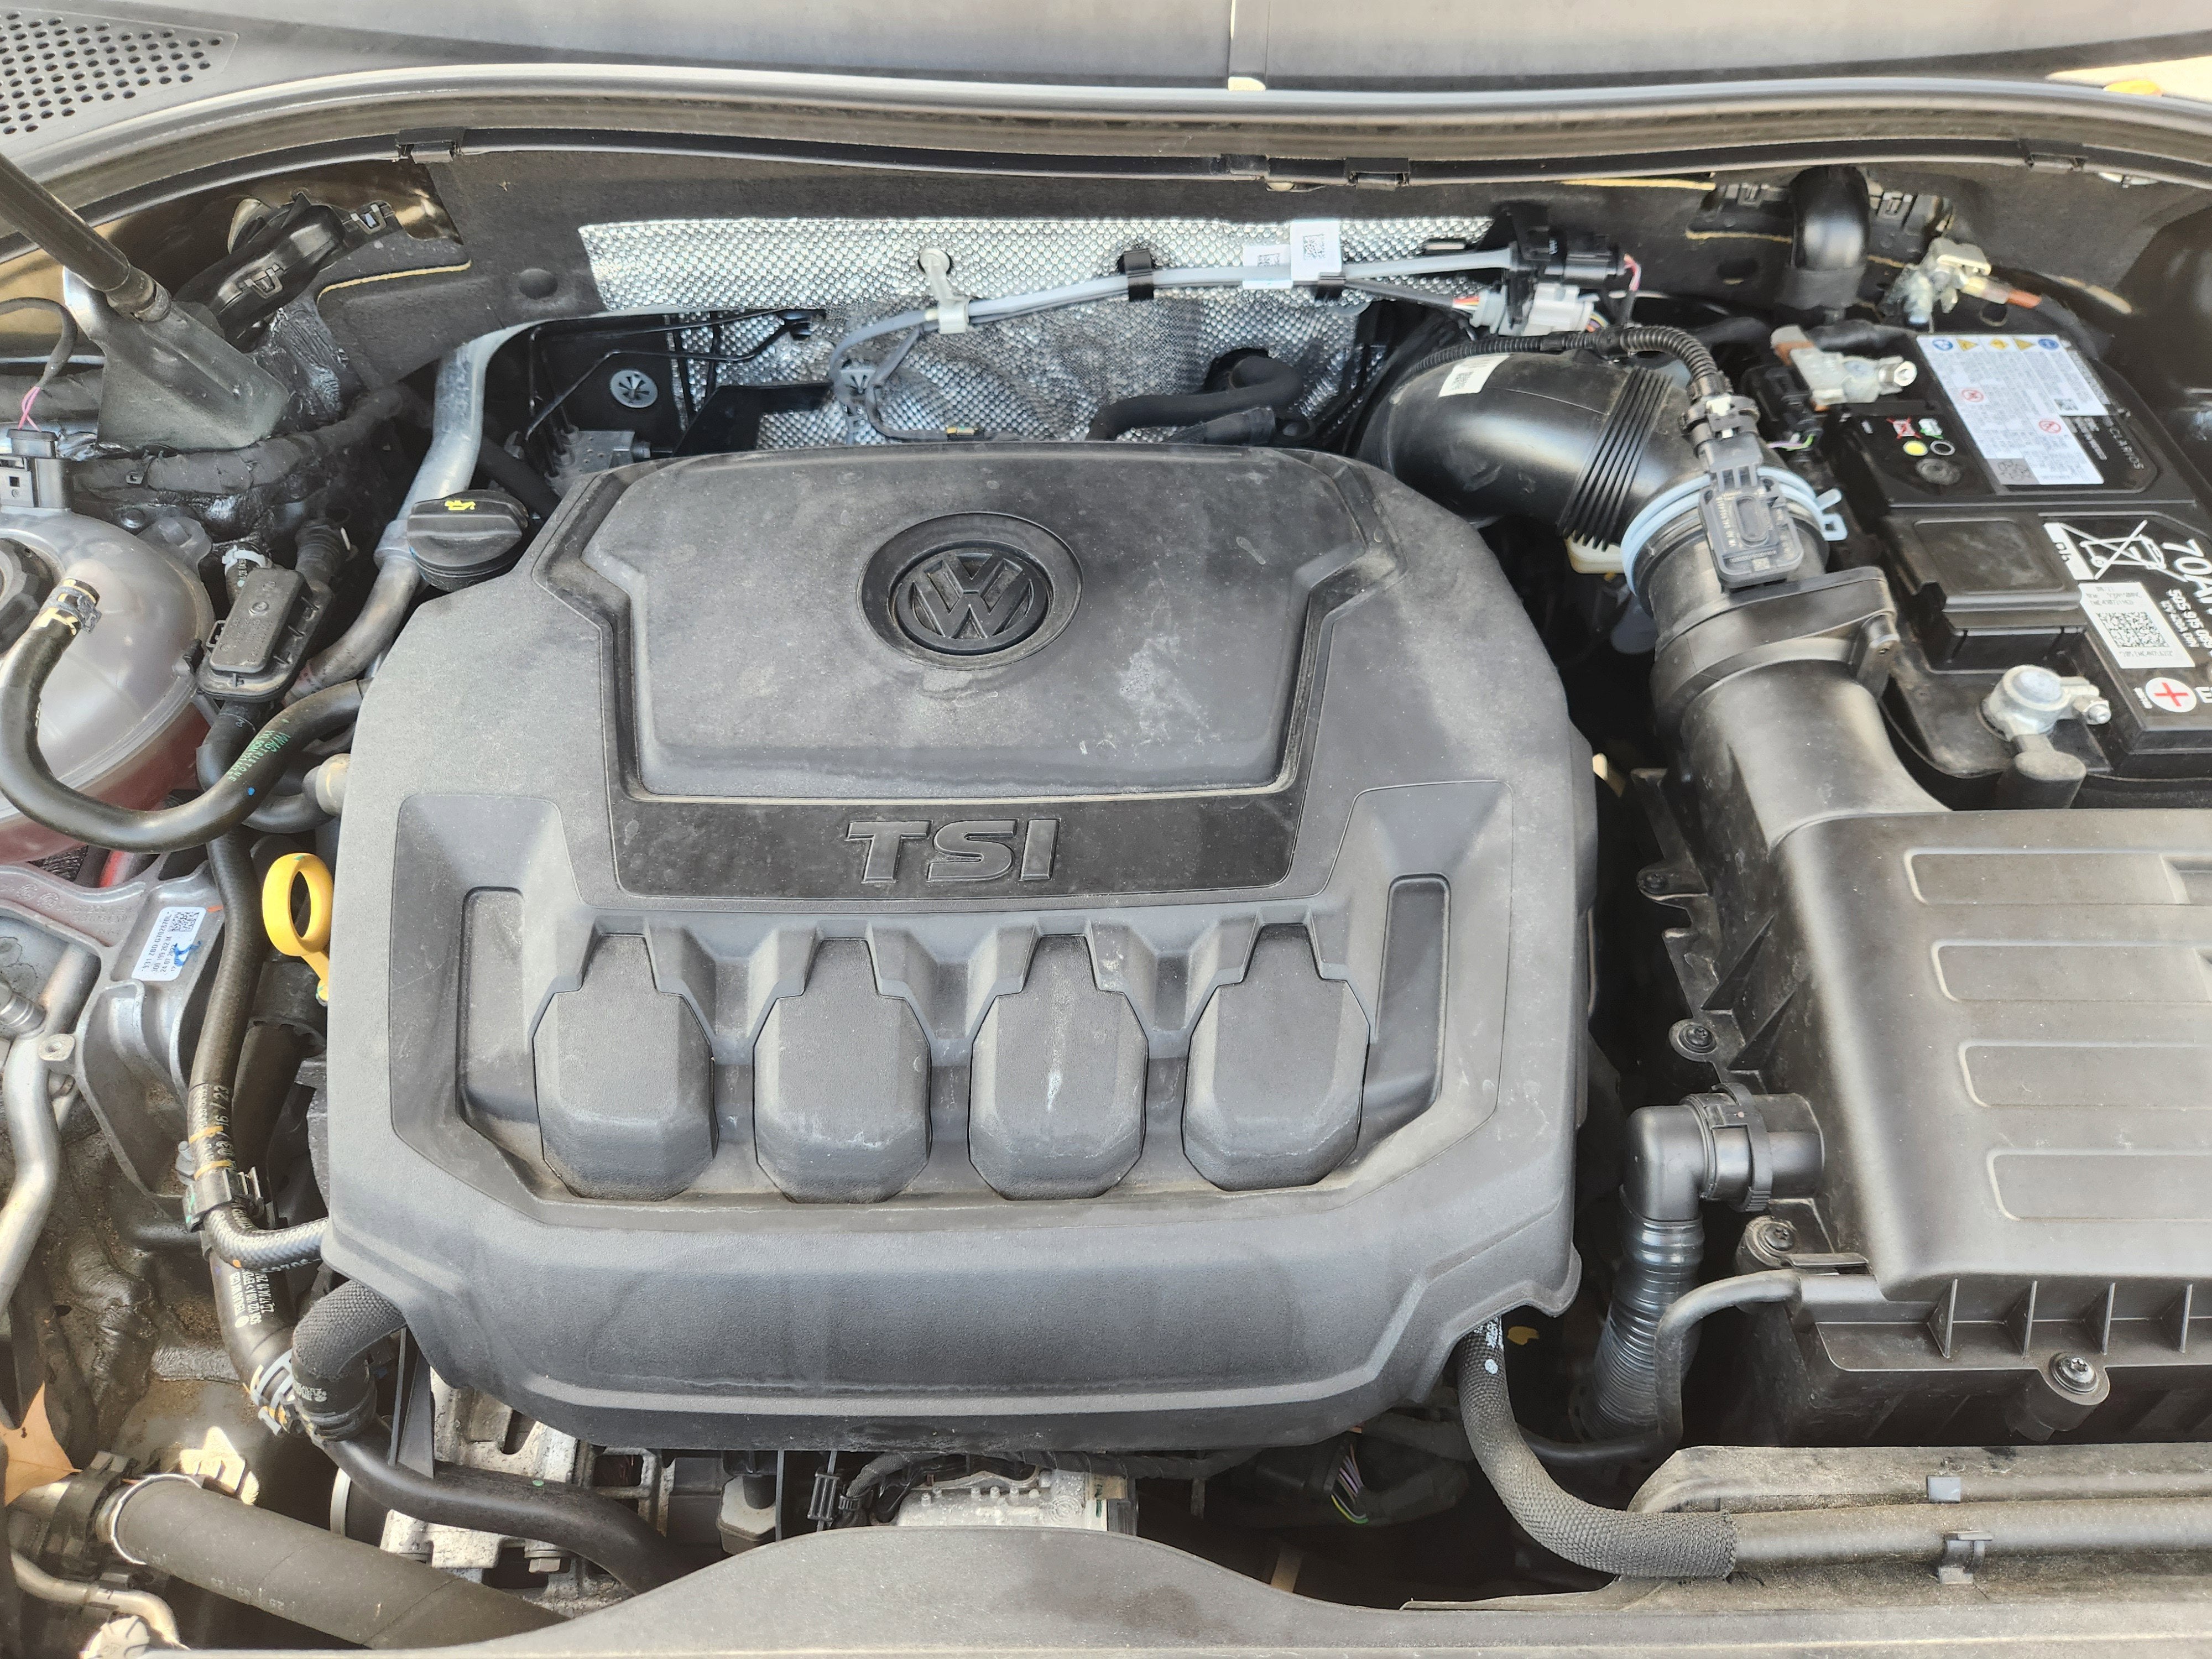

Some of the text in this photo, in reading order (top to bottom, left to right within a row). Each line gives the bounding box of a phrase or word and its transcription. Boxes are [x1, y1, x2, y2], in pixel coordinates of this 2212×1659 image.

[2109, 426, 2145, 469] CLARIOS
[896, 547, 1047, 650] VW
[2162, 539, 2212, 614] 70A
[844, 818, 1062, 884] TSI
[213, 1085, 229, 1102] 23
